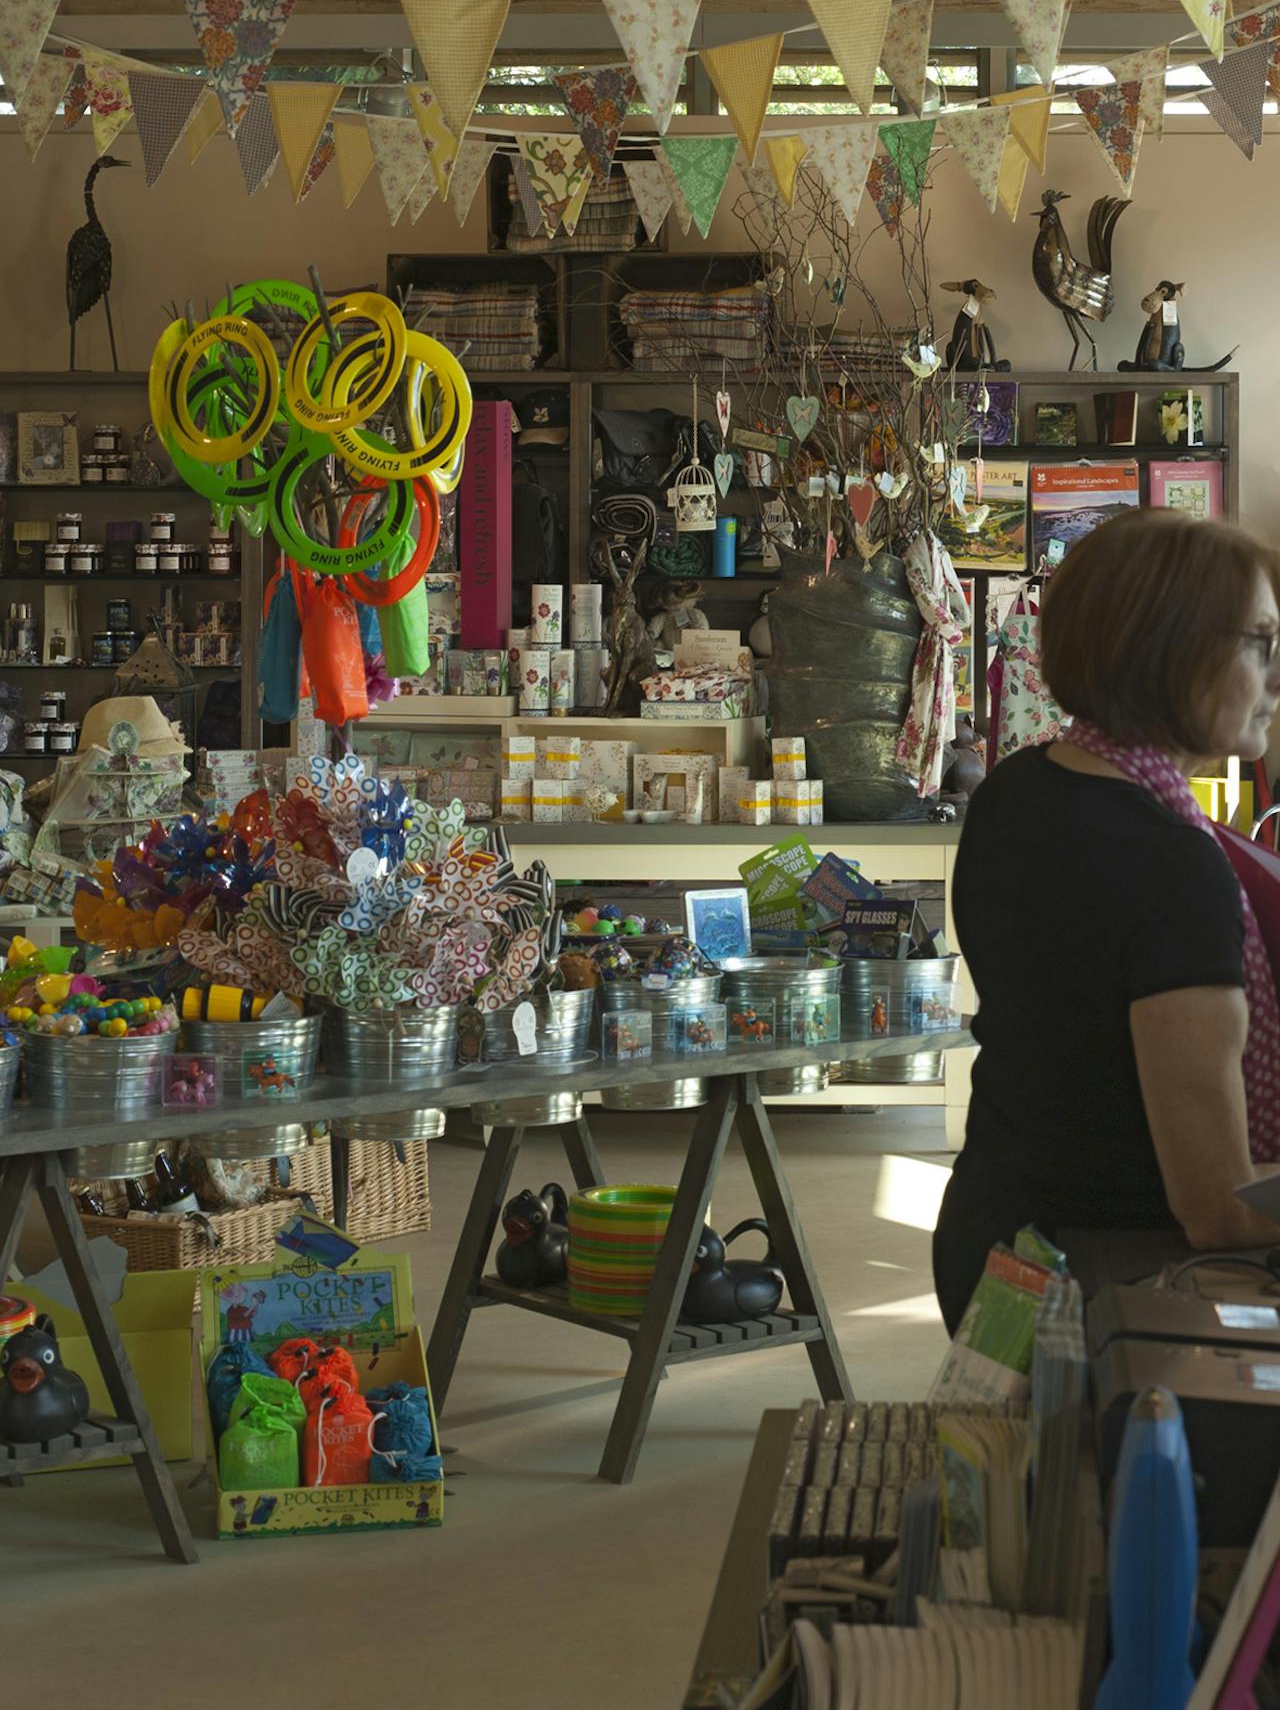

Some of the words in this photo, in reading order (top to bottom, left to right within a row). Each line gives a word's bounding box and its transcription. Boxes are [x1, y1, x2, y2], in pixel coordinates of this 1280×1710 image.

[192, 323, 222, 347] FLYING
[224, 322, 249, 337] RING
[294, 399, 316, 419] RING
[316, 409, 351, 422] FLYING
[357, 451, 400, 471] FLYING
[474, 463, 494, 504] and
[345, 539, 385, 564] FLYING
[474, 508, 494, 587] refresh
[310, 552, 341, 565] RING
[845, 910, 862, 924] SPY
[862, 910, 898, 925] GLASSES
[276, 1276, 386, 1301] POCKET
[300, 1296, 362, 1316] KITES
[284, 1489, 358, 1506] POCKET
[362, 1485, 415, 1505] KITES
